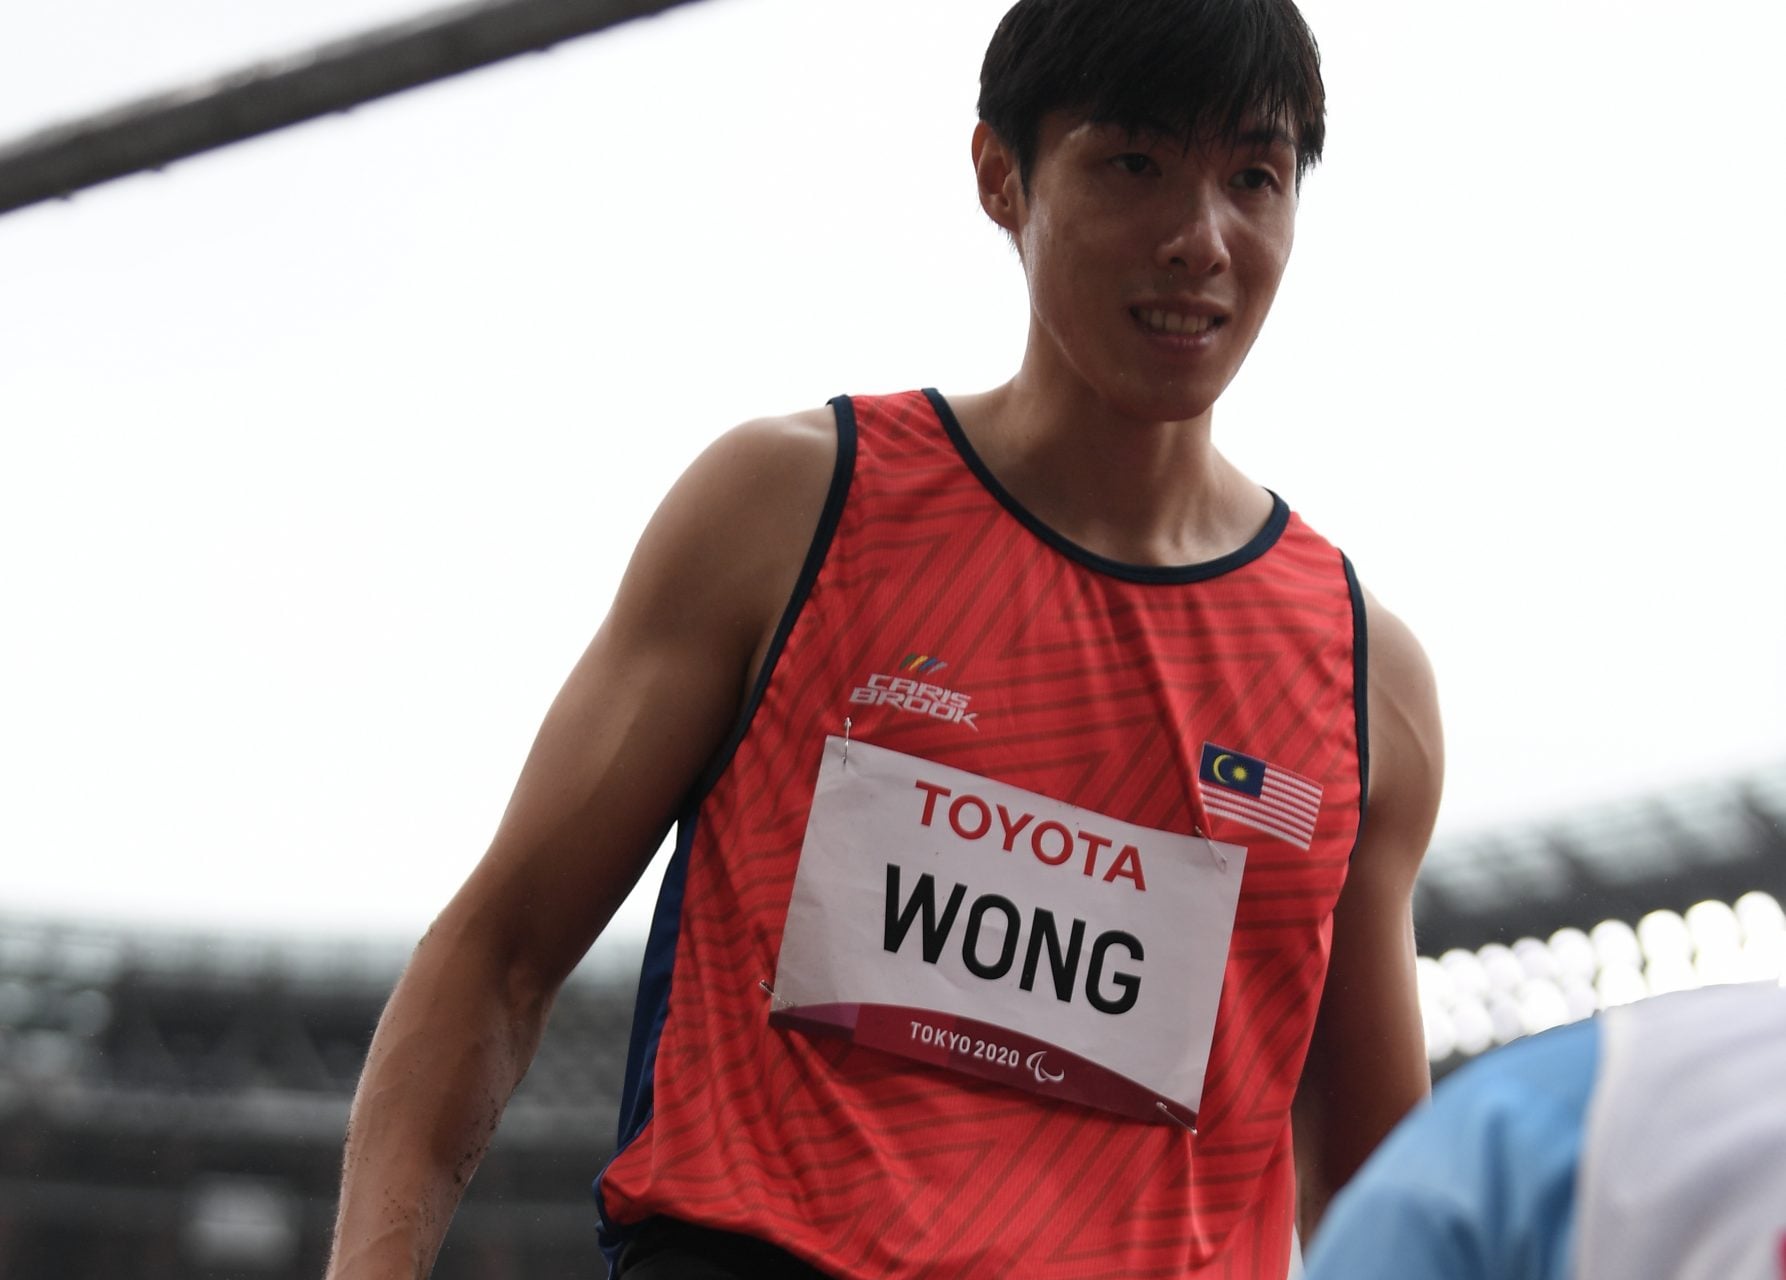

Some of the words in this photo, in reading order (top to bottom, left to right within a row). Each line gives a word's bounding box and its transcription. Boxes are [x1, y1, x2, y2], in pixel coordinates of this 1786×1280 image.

[849, 687, 980, 732] BROOK
[868, 673, 972, 708] CARIS
[914, 779, 1147, 891] TOYOTA
[882, 863, 1145, 1016] WONG
[909, 1021, 971, 1055] TOKYO
[973, 1039, 1020, 1068] 2020
